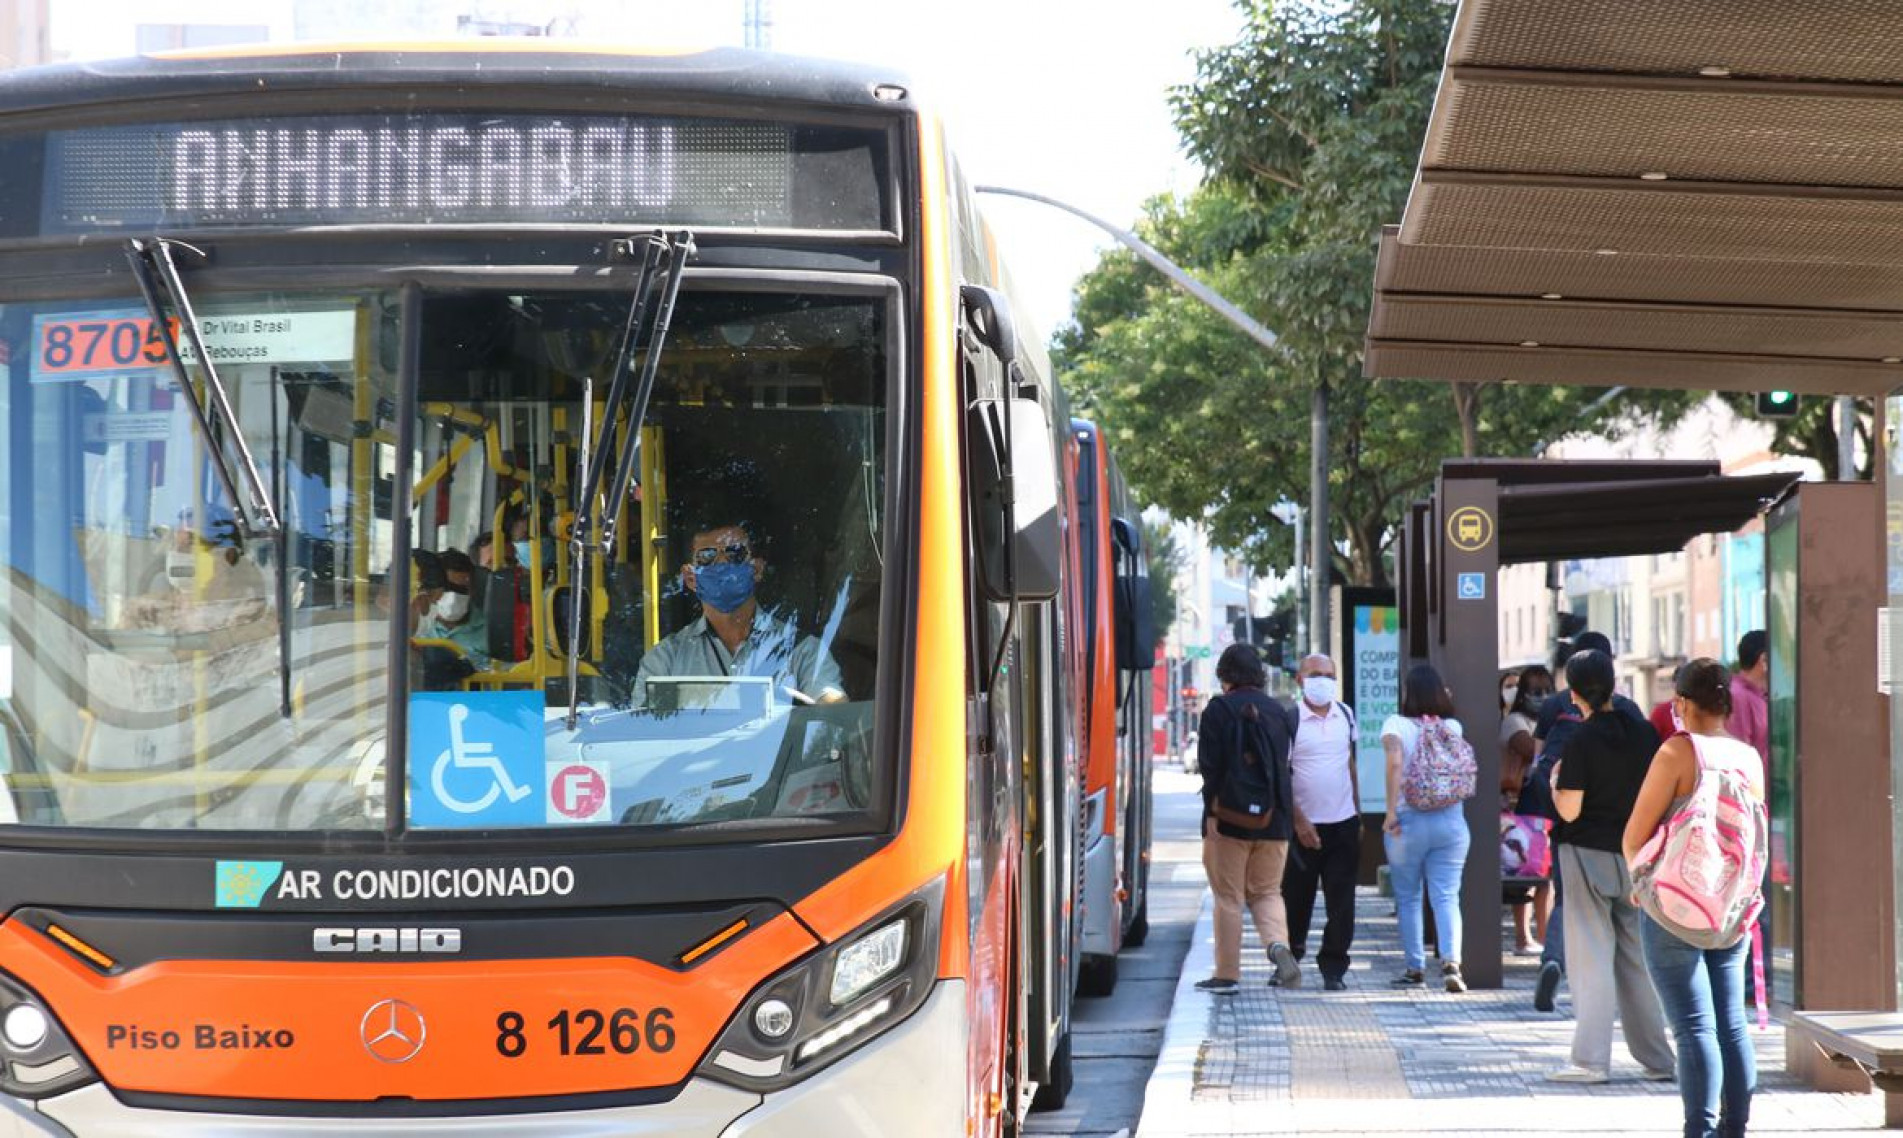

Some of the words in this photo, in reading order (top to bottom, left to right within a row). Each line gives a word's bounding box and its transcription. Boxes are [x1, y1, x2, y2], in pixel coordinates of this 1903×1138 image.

[175, 126, 674, 209] ANHANGABAU
[203, 320, 219, 335] Dr
[222, 319, 250, 334] Vital
[253, 318, 291, 334] Brasil
[44, 321, 172, 368] 8705
[1360, 667, 1380, 681] DO
[565, 773, 592, 811] F
[277, 869, 322, 899] AR
[333, 865, 575, 899] CONDICIONADO
[313, 927, 462, 953] CAIO
[106, 1024, 181, 1049] Piso
[194, 1024, 295, 1049] Baixo
[496, 1010, 527, 1058] 8
[547, 1006, 676, 1056] 1266
